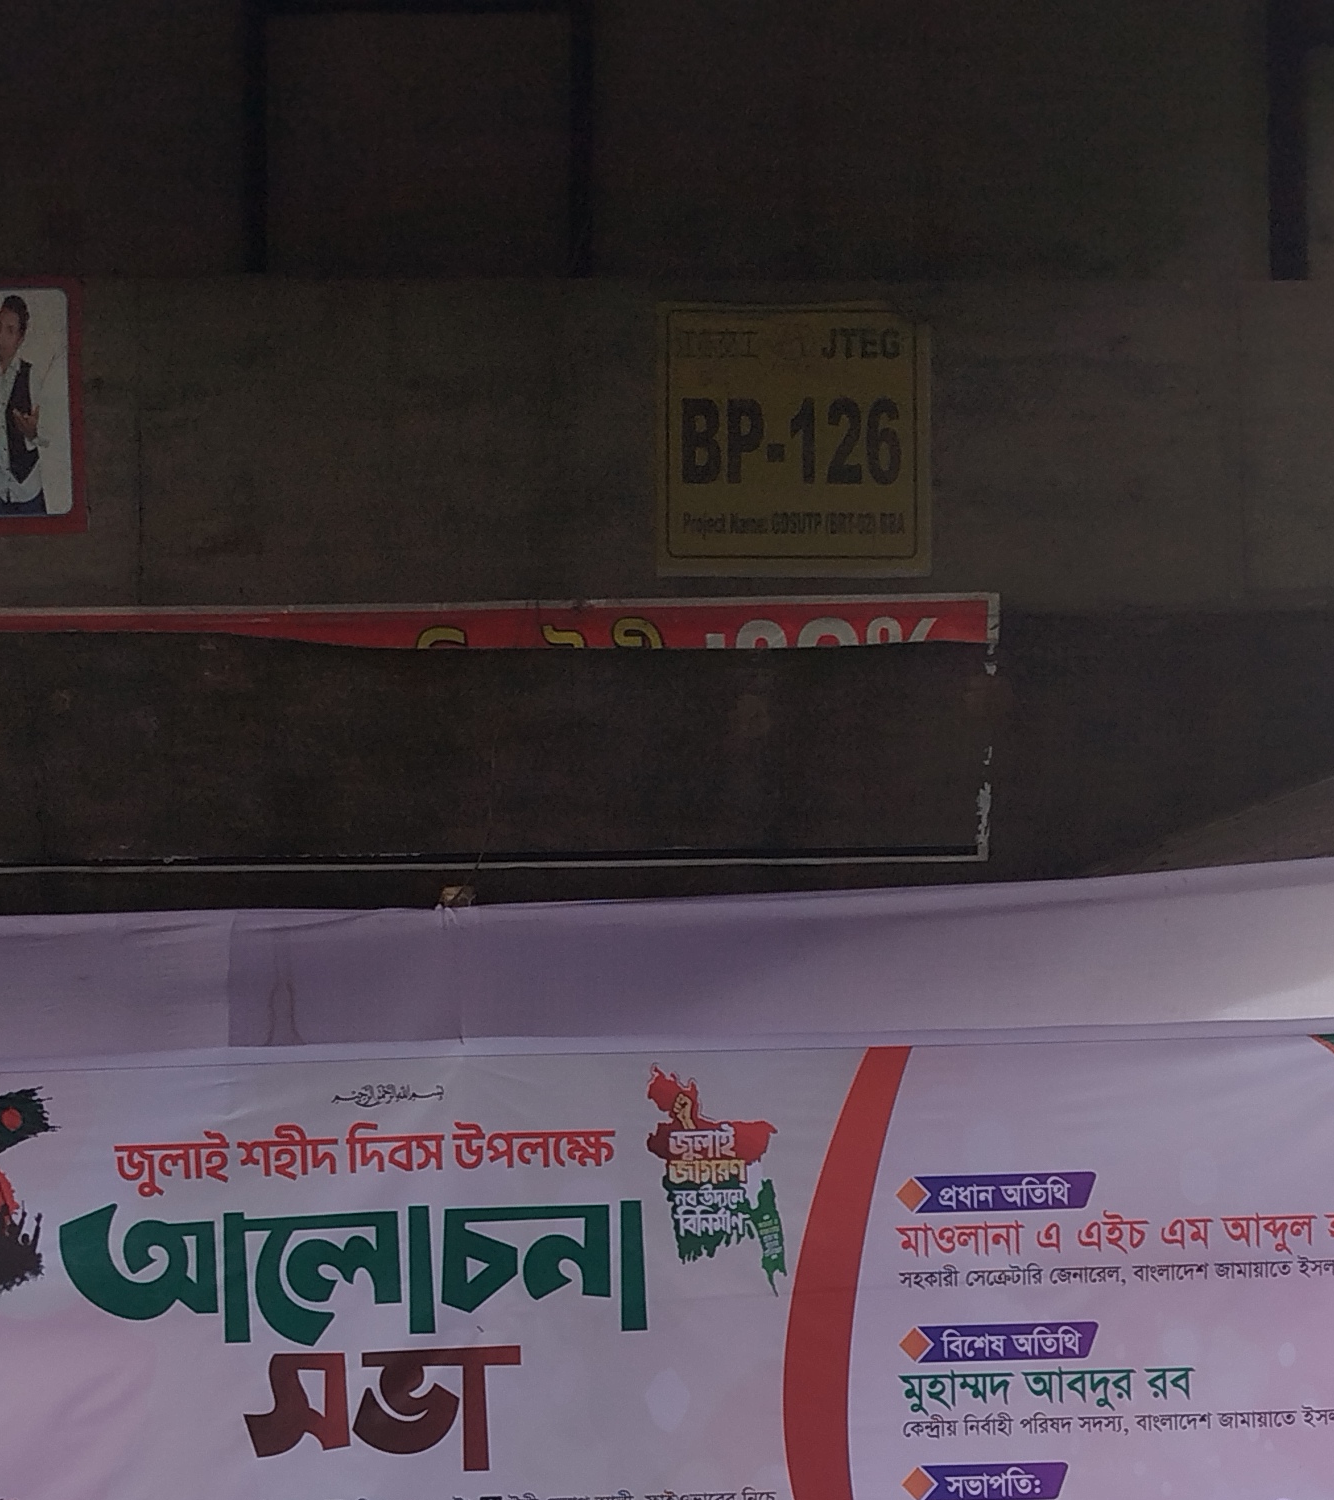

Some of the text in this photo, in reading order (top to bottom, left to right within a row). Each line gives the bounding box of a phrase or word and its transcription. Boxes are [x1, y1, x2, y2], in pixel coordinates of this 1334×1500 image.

[822, 328, 900, 359] JTEG
[682, 396, 902, 485] BP-126
[669, 1123, 736, 1160] জুলাই
[114, 1120, 616, 1199] জুলাই শহীদ দিবস উপলক্ষে
[669, 1158, 747, 1184] জাগরণ
[674, 1189, 697, 1206] নব
[938, 1178, 1071, 1209] প্রধান অতিথি
[674, 1206, 751, 1236] বিনির্মাণ
[895, 1219, 1024, 1258] মাওলানা
[1037, 1224, 1061, 1252] এ
[1077, 1210, 1148, 1253] এইচ
[1160, 1217, 1214, 1250] এম
[1223, 1210, 1317, 1253] আব্দুল
[58, 1199, 648, 1348] আলোচনা
[898, 1264, 960, 1290] সহকারী
[965, 1261, 1043, 1287] সেক্রেটারি
[1049, 1262, 1127, 1287] জেনারেল,
[1133, 1262, 1208, 1285] বাংলাদেশ
[1214, 1259, 1292, 1282] জামায়াতে
[941, 1327, 1080, 1360] বিশেষ অতিথি
[898, 1366, 1194, 1414] মুহাম্মদ আবদুর রব
[243, 1345, 521, 1471] সভা
[902, 1413, 958, 1441] কেন্দ্রীয়
[963, 1412, 1014, 1437] নির্বাহী
[1019, 1412, 1073, 1435] পরিষদ
[1079, 1415, 1130, 1436] সদস্য,
[1135, 1412, 1212, 1432] বাংলাদেশ
[1218, 1408, 1296, 1431] জামায়াতে
